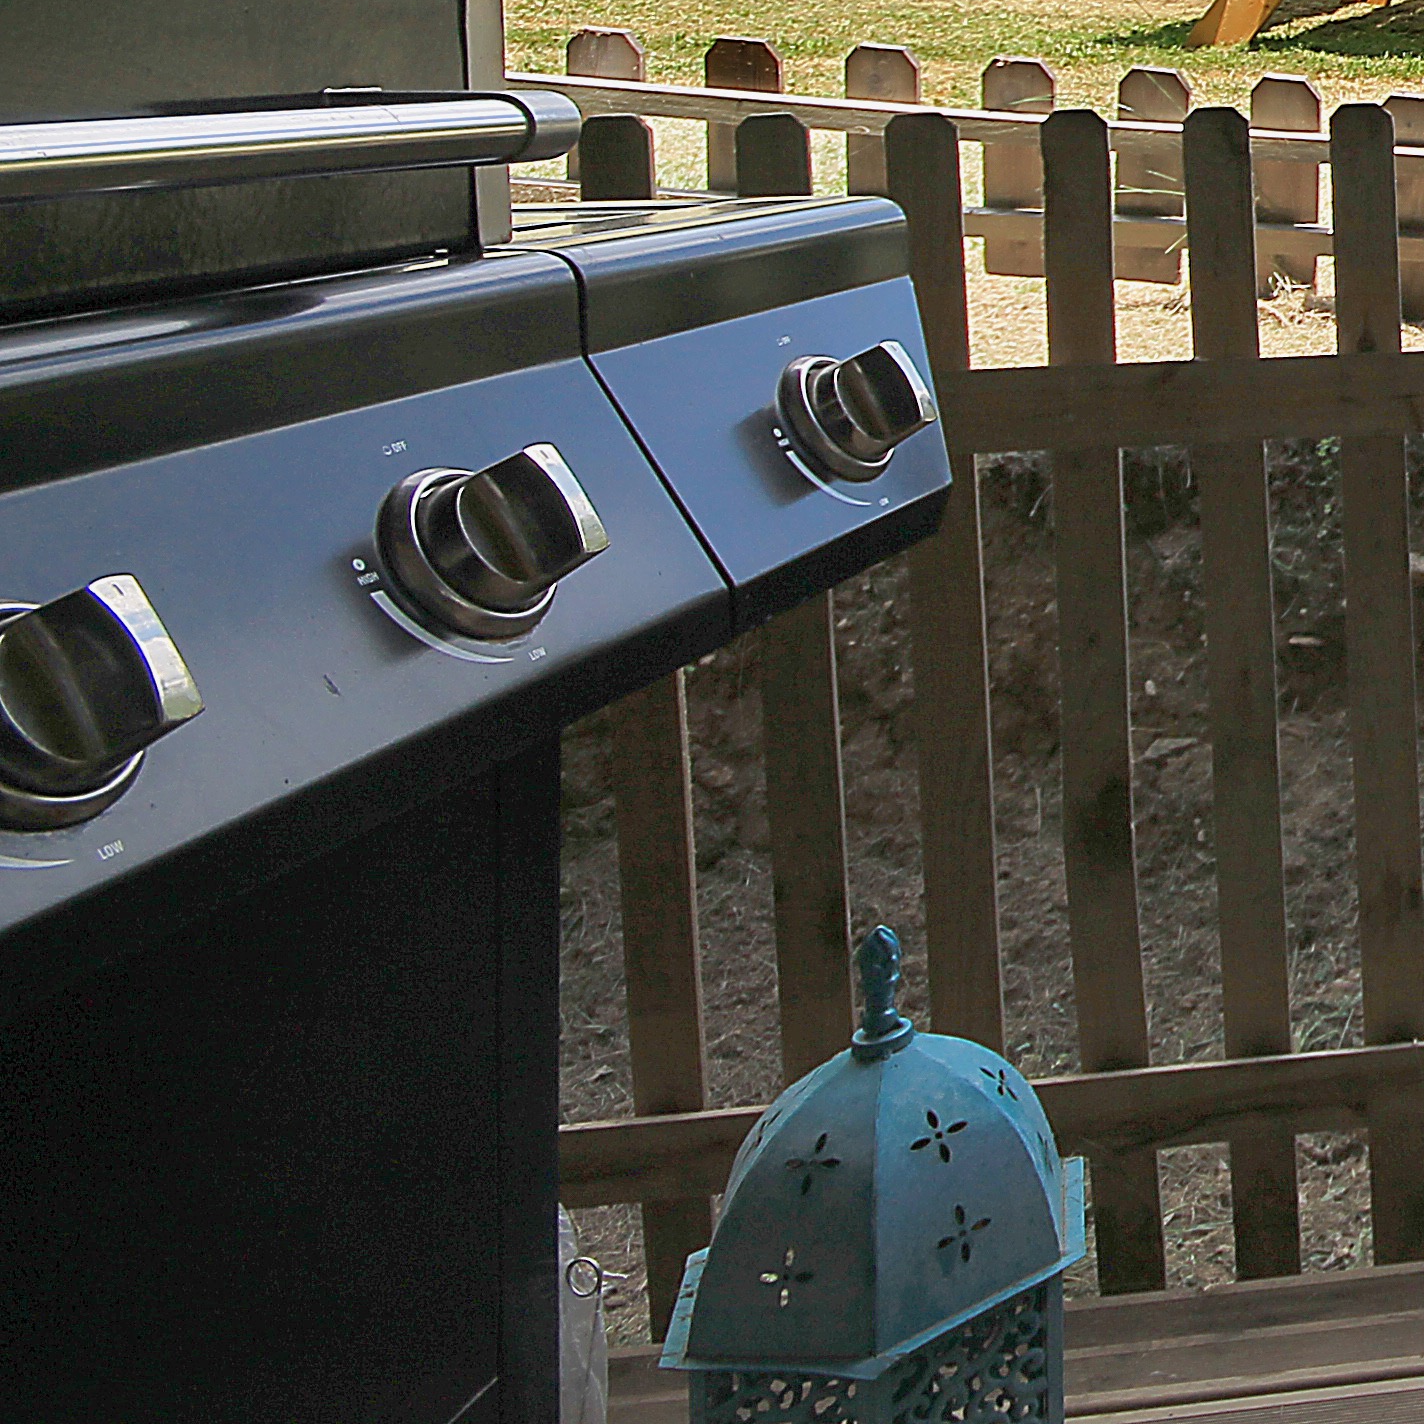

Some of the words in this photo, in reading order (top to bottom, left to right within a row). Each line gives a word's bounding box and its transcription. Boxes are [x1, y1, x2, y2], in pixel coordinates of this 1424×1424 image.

[357, 571, 380, 586] HIGH
[528, 646, 547, 661] LOW
[96, 839, 124, 860] LOW
